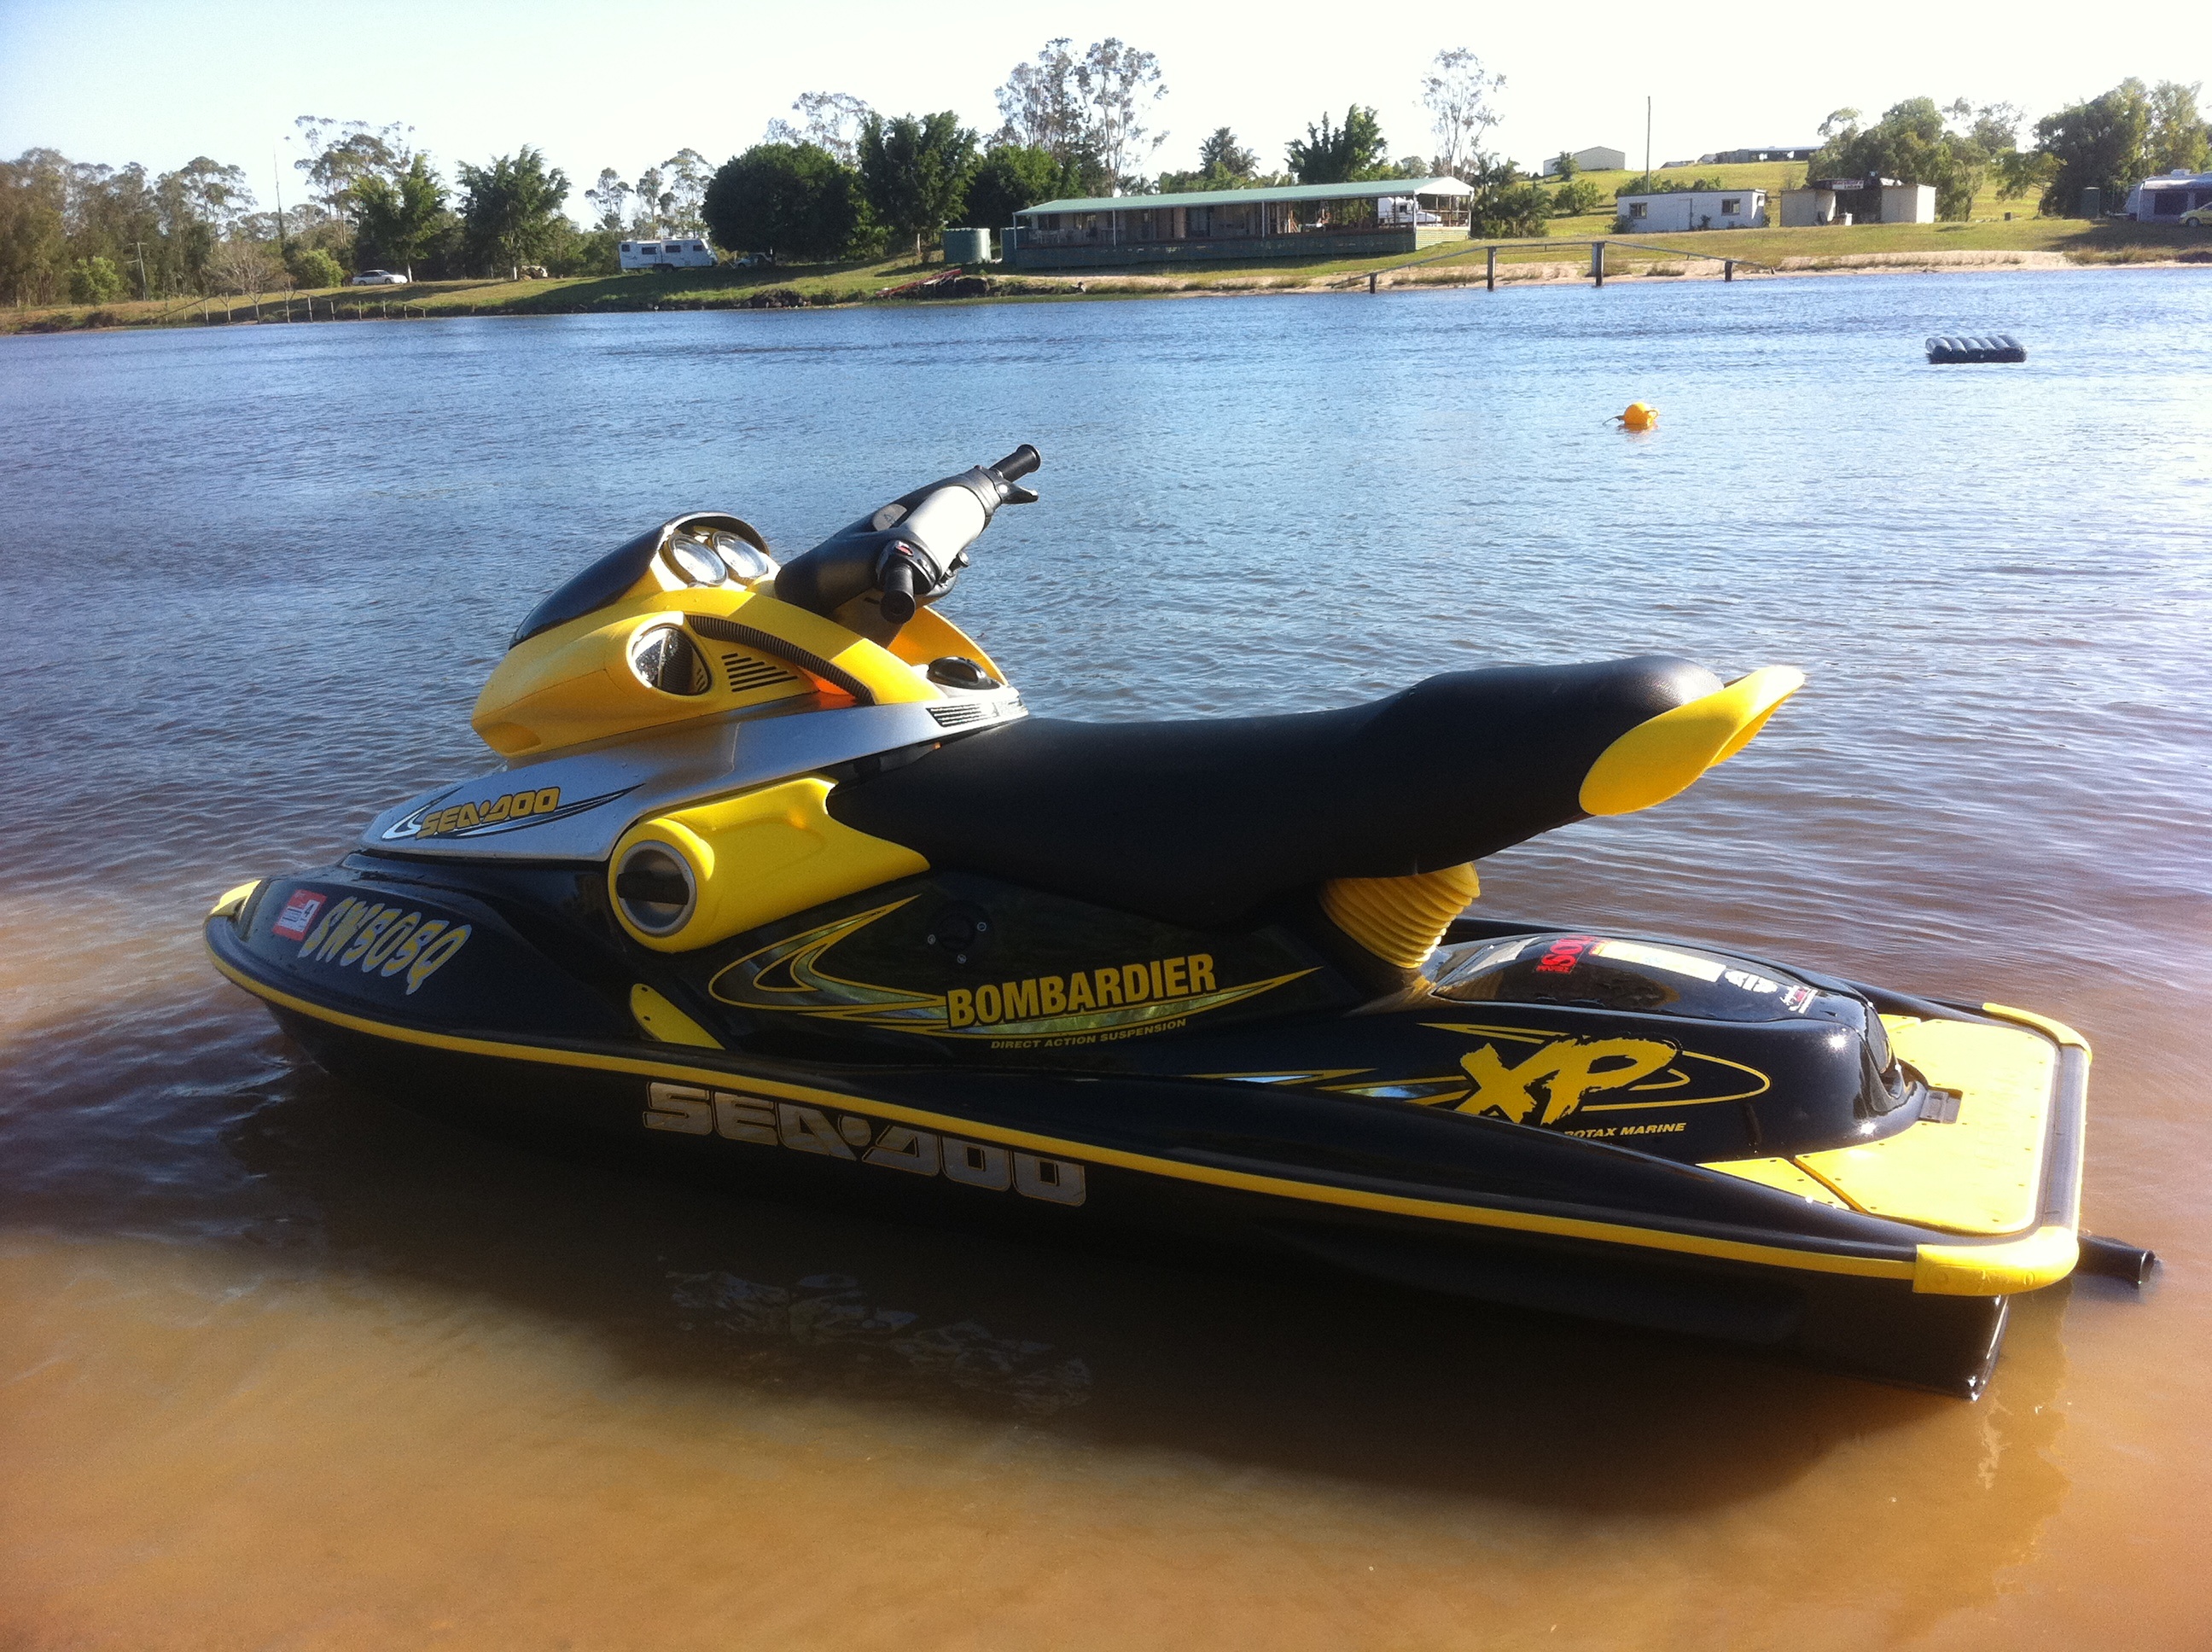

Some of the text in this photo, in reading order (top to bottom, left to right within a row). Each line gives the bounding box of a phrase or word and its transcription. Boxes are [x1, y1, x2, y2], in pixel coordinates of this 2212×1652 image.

[947, 953, 1217, 1028] BOMBARDIER
[991, 1018, 1187, 1049] DIRECT ACTION SUSPENSION
[1454, 1036, 1679, 1126] XP
[1620, 1122, 1686, 1136] MARINE
